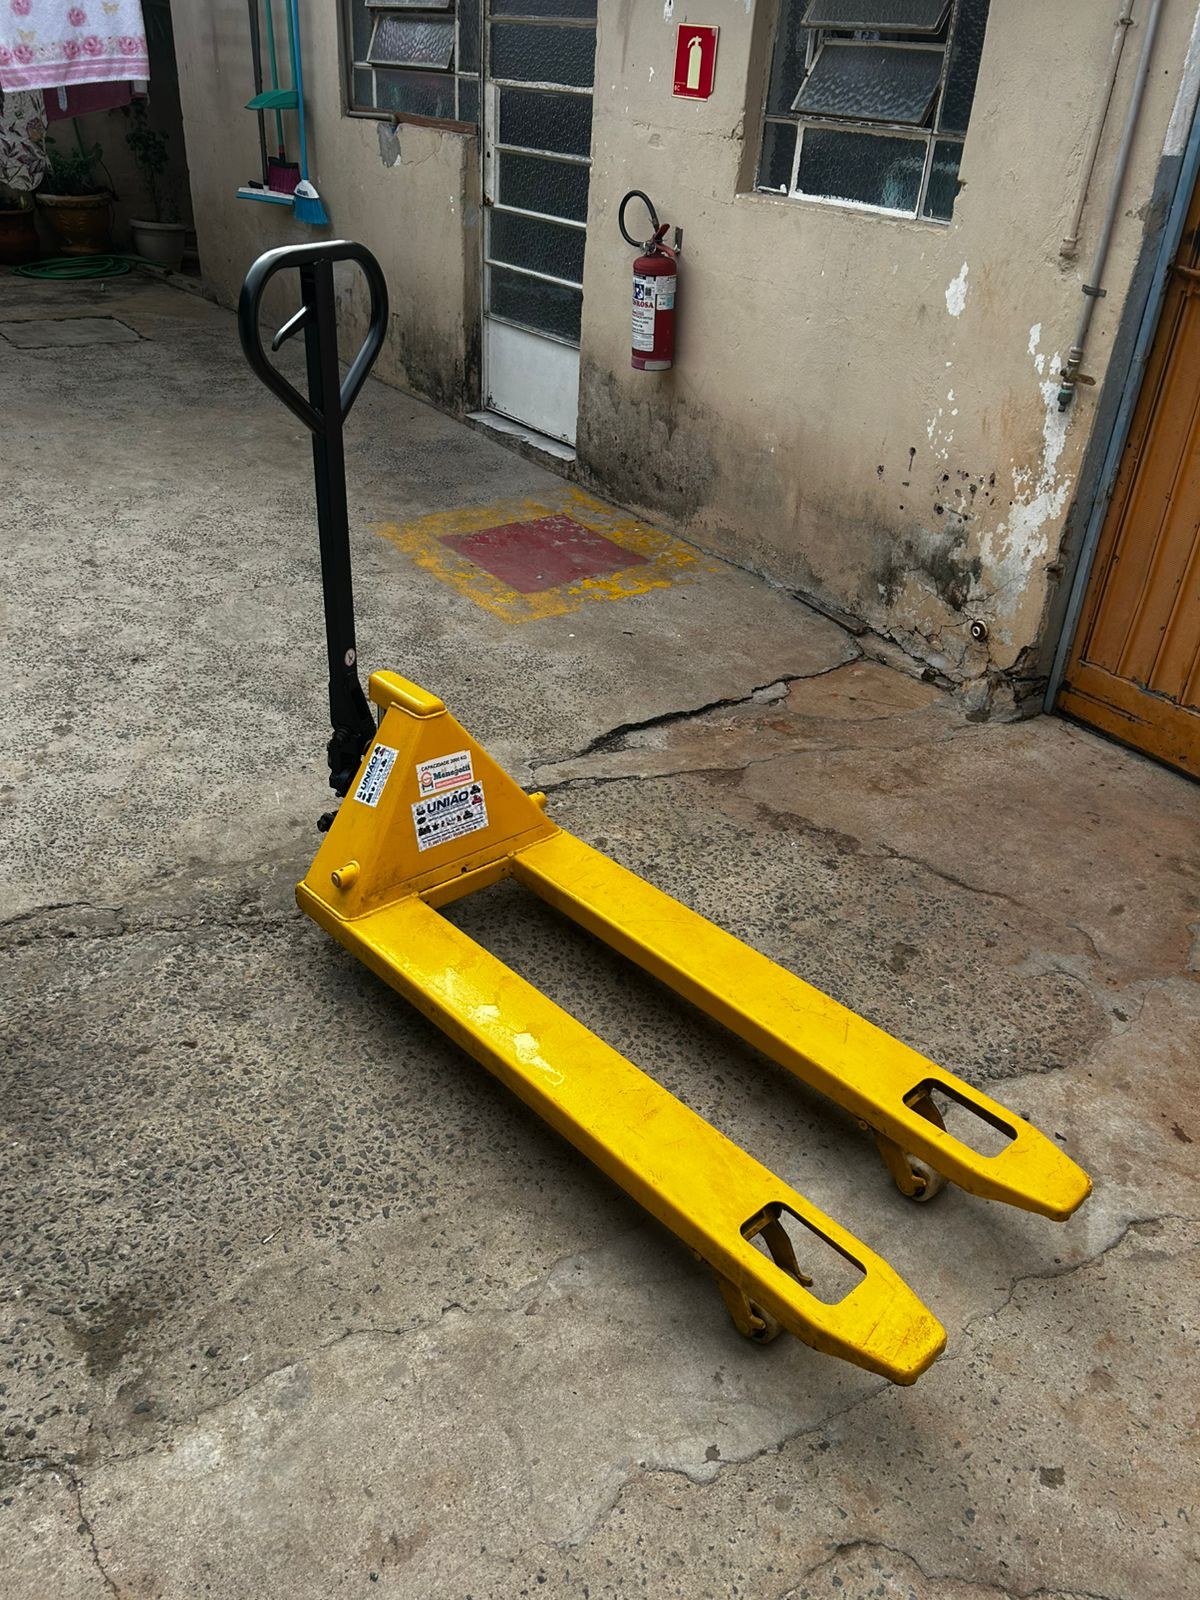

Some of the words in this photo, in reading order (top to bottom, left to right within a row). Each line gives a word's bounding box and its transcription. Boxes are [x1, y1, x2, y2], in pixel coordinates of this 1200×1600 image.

[361, 756, 378, 790] UNIÃO
[421, 759, 450, 772] CAPACIDADE
[426, 790, 469, 814] UNIÃO
